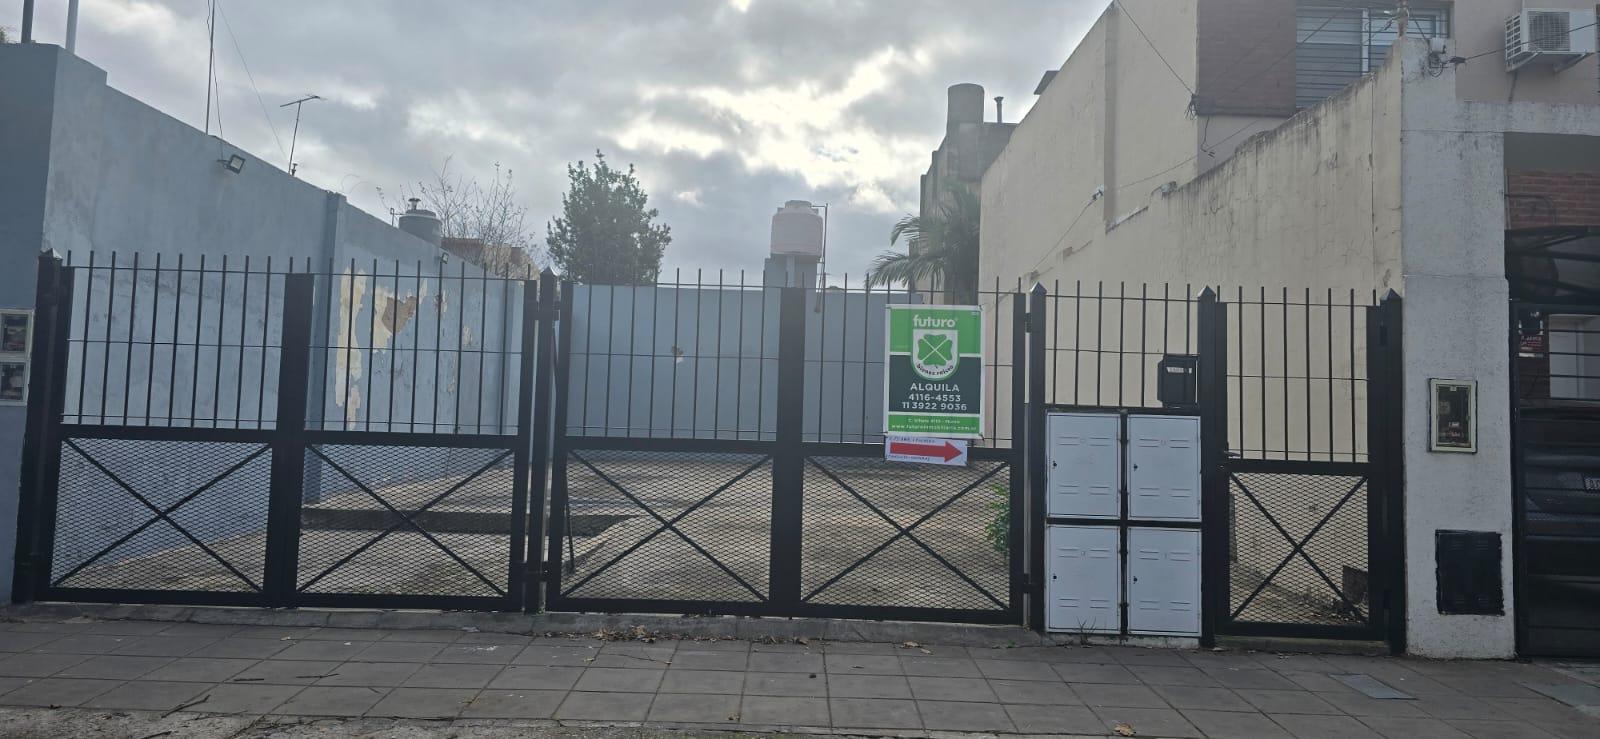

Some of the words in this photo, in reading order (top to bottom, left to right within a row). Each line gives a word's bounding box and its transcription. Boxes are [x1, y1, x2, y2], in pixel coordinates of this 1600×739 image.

[912, 314, 956, 328] futuro
[910, 382, 960, 392] ALQUILA
[908, 393, 961, 402] 4116-4553
[901, 401, 909, 409] 11
[911, 401, 937, 410] 3922
[940, 403, 967, 411] 9036
